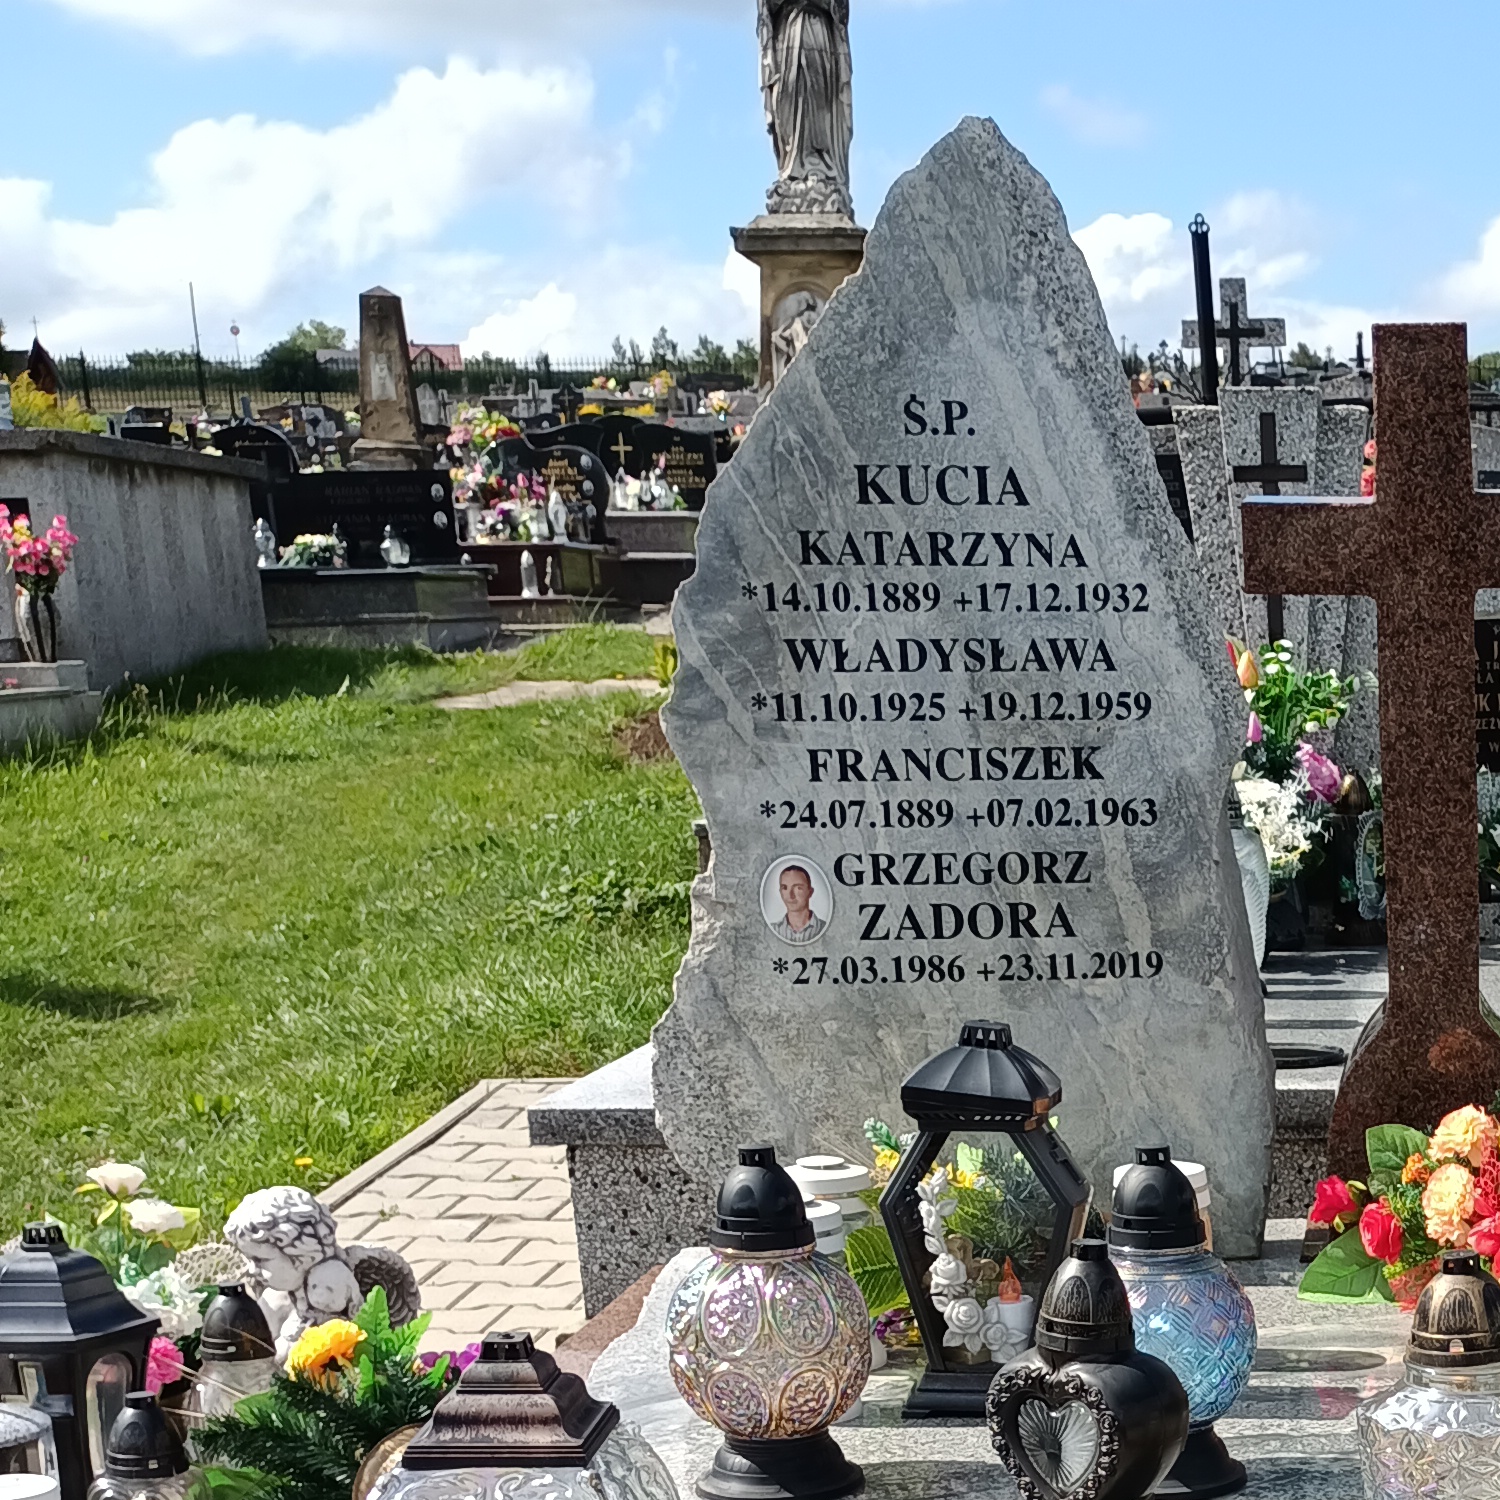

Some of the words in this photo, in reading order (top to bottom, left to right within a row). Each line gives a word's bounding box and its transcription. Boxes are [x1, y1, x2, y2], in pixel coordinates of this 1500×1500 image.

[903, 393, 976, 437] Ś.P.
[853, 464, 1031, 507] KUCIA
[795, 527, 1089, 568] KATARZYNA
[952, 582, 1150, 614] +17.12.1932
[782, 637, 1118, 674] WŁADYSŁAWA
[958, 691, 1152, 722] +19.12.1959
[806, 744, 1105, 783] FRANCISZEK
[966, 797, 1158, 828] +07.02.1963
[833, 850, 1092, 887] GRZEGORZ
[858, 901, 1078, 941] ZADORA
[976, 950, 1164, 983] +23.11.2019
